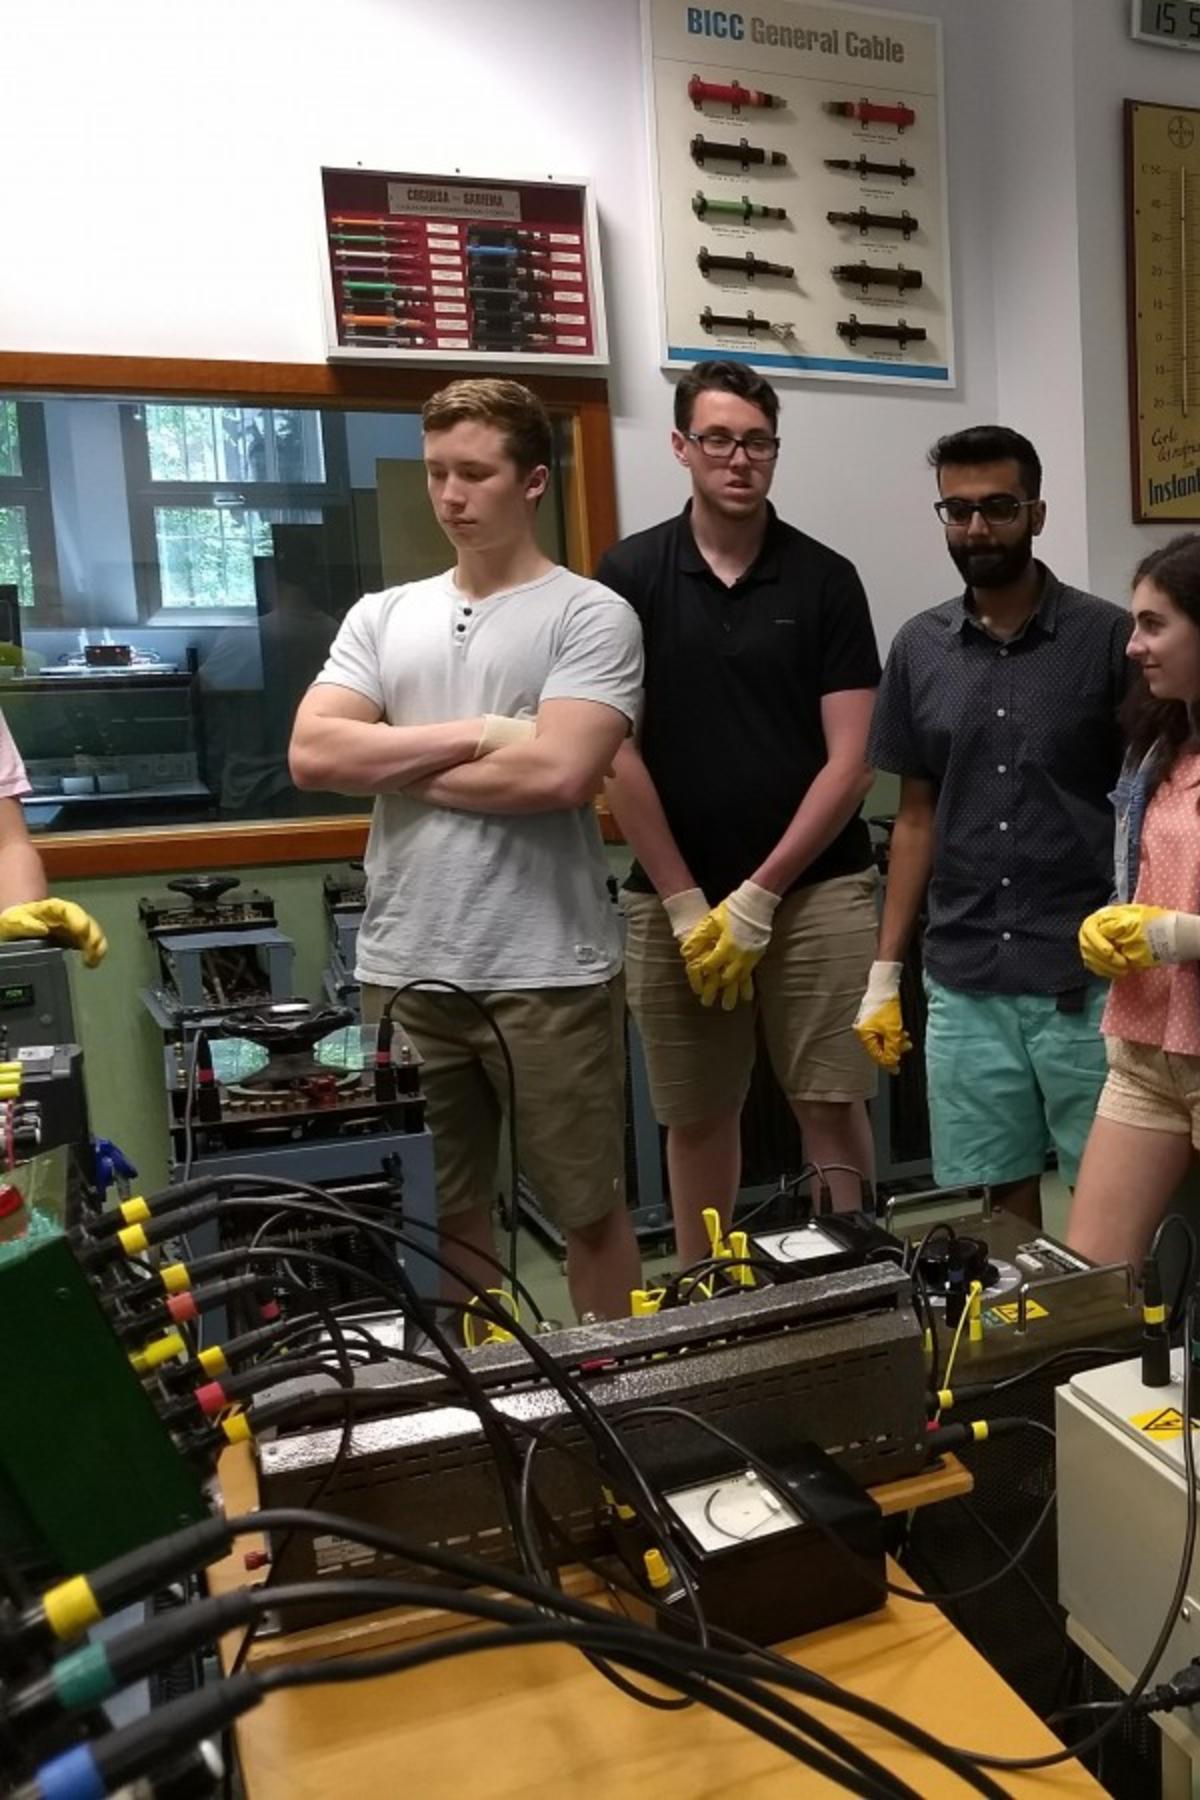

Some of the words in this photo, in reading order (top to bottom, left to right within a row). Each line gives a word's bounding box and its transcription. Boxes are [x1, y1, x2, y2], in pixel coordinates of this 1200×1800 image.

[687, 7, 744, 41] BICC
[751, 17, 839, 55] General
[846, 31, 905, 64] Cable
